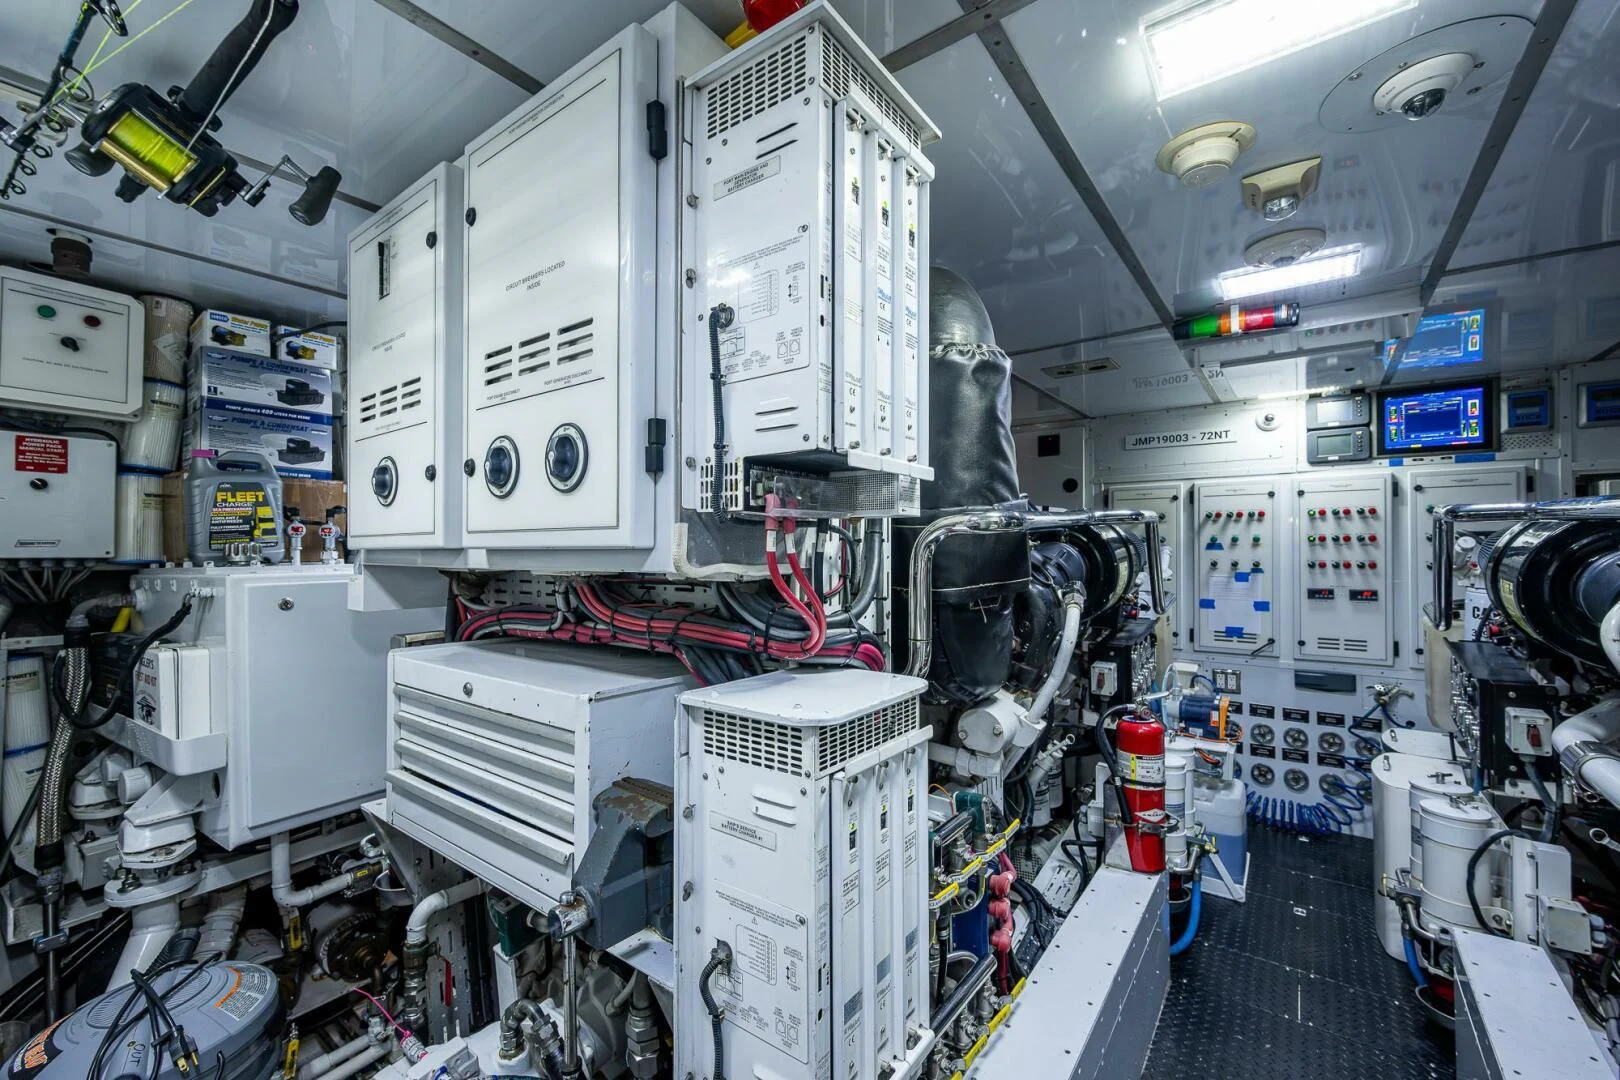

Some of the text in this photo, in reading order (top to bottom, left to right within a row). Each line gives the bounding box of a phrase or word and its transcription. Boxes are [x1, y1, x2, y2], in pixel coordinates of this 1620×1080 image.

[505, 260, 566, 292] CIRCUIT BREAKERS LOCATED
[526, 280, 541, 291] INSIDE
[232, 416, 258, 426] POMPE
[266, 422, 310, 433] CONDENSAT
[1132, 434, 1189, 447] JMP19003
[1200, 430, 1231, 441] 72NT
[216, 492, 264, 502] FLEET
[130, 1044, 146, 1068] OUT
